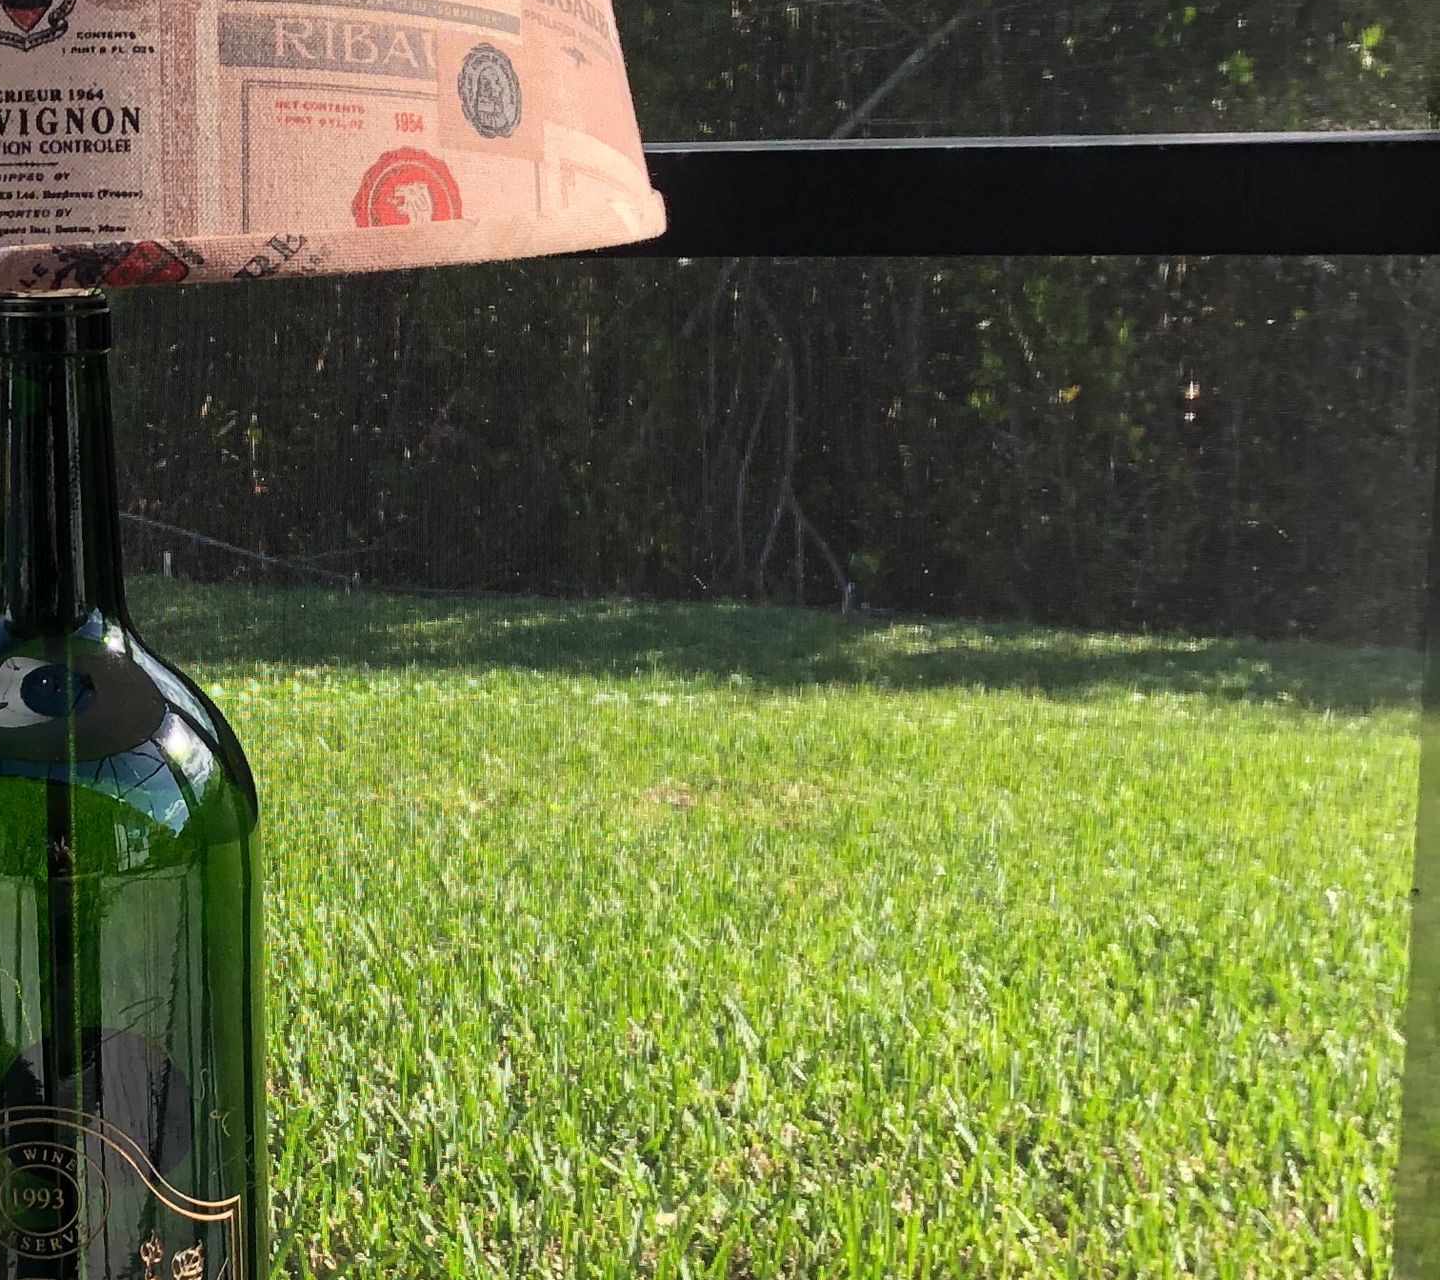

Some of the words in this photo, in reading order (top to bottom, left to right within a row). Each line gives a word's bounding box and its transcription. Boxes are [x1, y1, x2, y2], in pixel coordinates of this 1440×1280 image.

[76, 30, 137, 40] CONTENTS
[68, 88, 105, 103] 1964
[302, 101, 365, 115] CONTENTS
[39, 139, 131, 154] CONTROLEE
[54, 171, 71, 182] BY
[56, 207, 73, 218] BY
[12, 1187, 65, 1210] 1993
